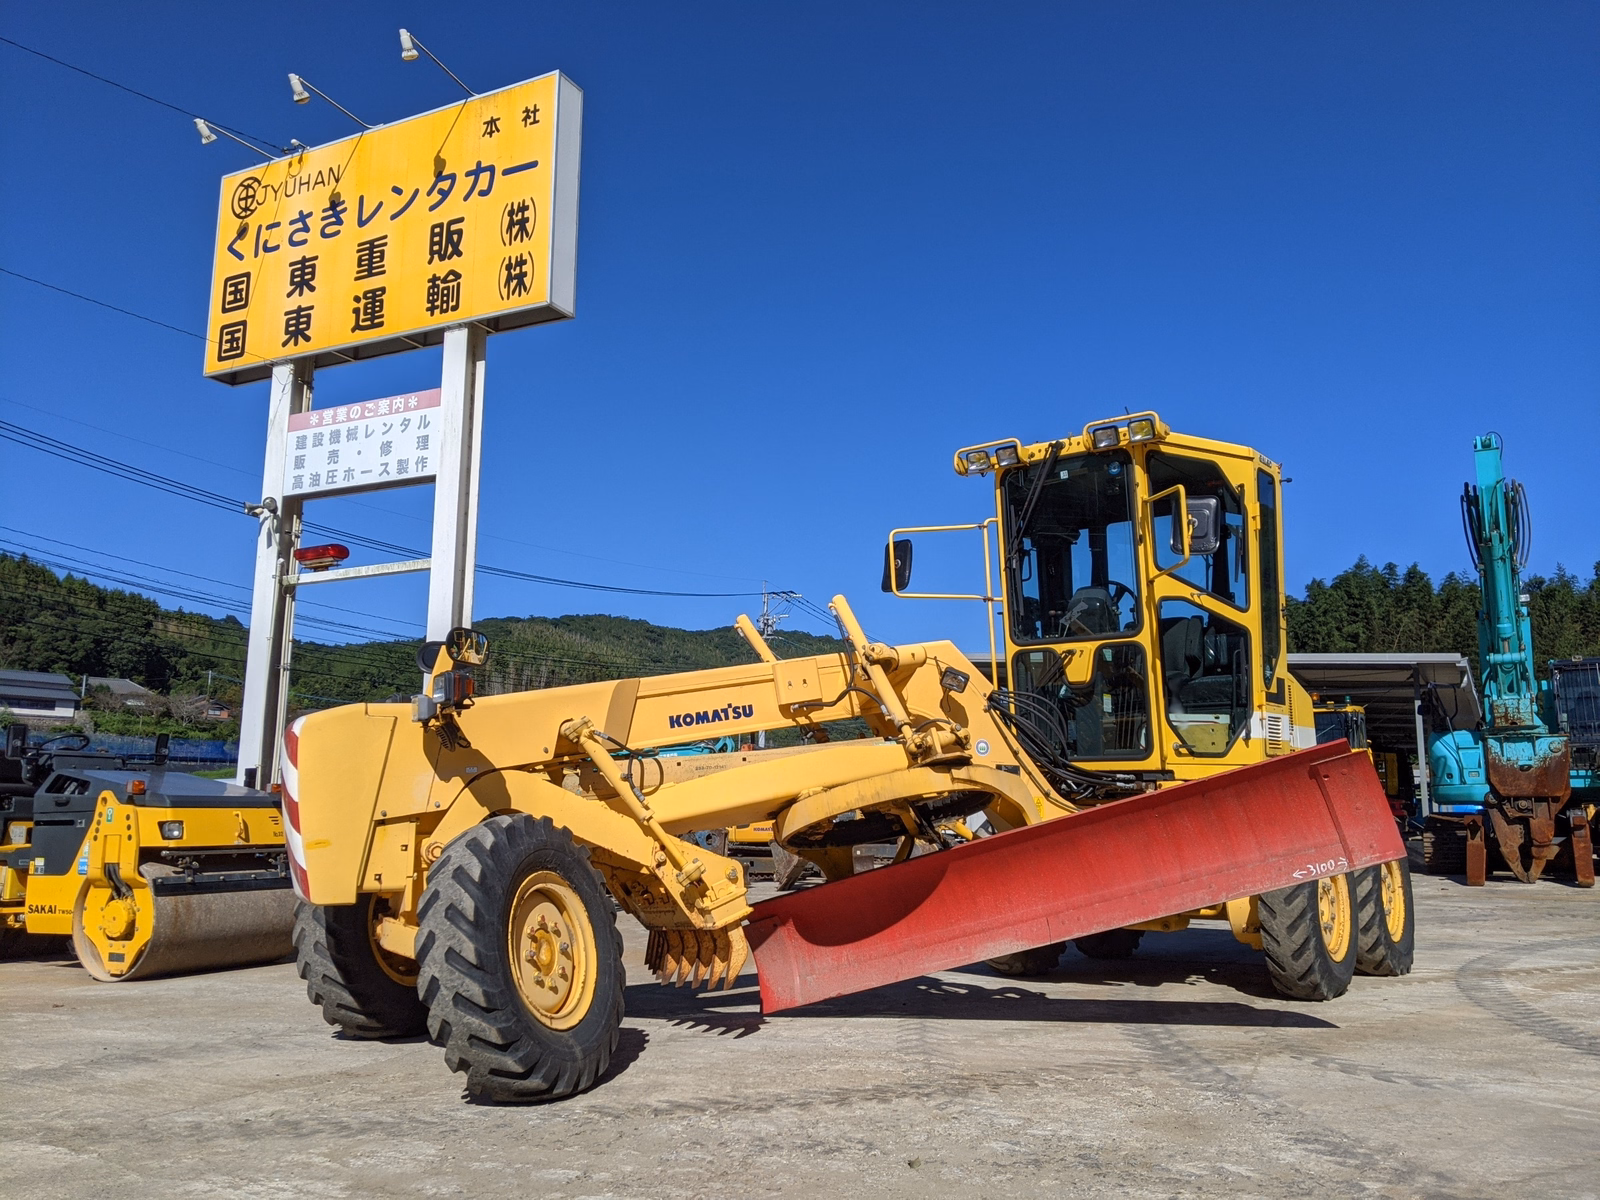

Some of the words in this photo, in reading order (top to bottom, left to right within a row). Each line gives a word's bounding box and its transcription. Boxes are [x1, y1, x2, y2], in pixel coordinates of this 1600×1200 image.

[482, 104, 541, 139] 本社
[256, 164, 341, 208] JYUHAN
[226, 160, 539, 262] くにさきレンタカー
[295, 414, 431, 451] 建設機械レンタル
[291, 455, 429, 491] 高油圧ホース製作
[668, 703, 754, 729] KOMATSU
[1306, 859, 1335, 876] 3100
[27, 904, 57, 915] SAKAI
